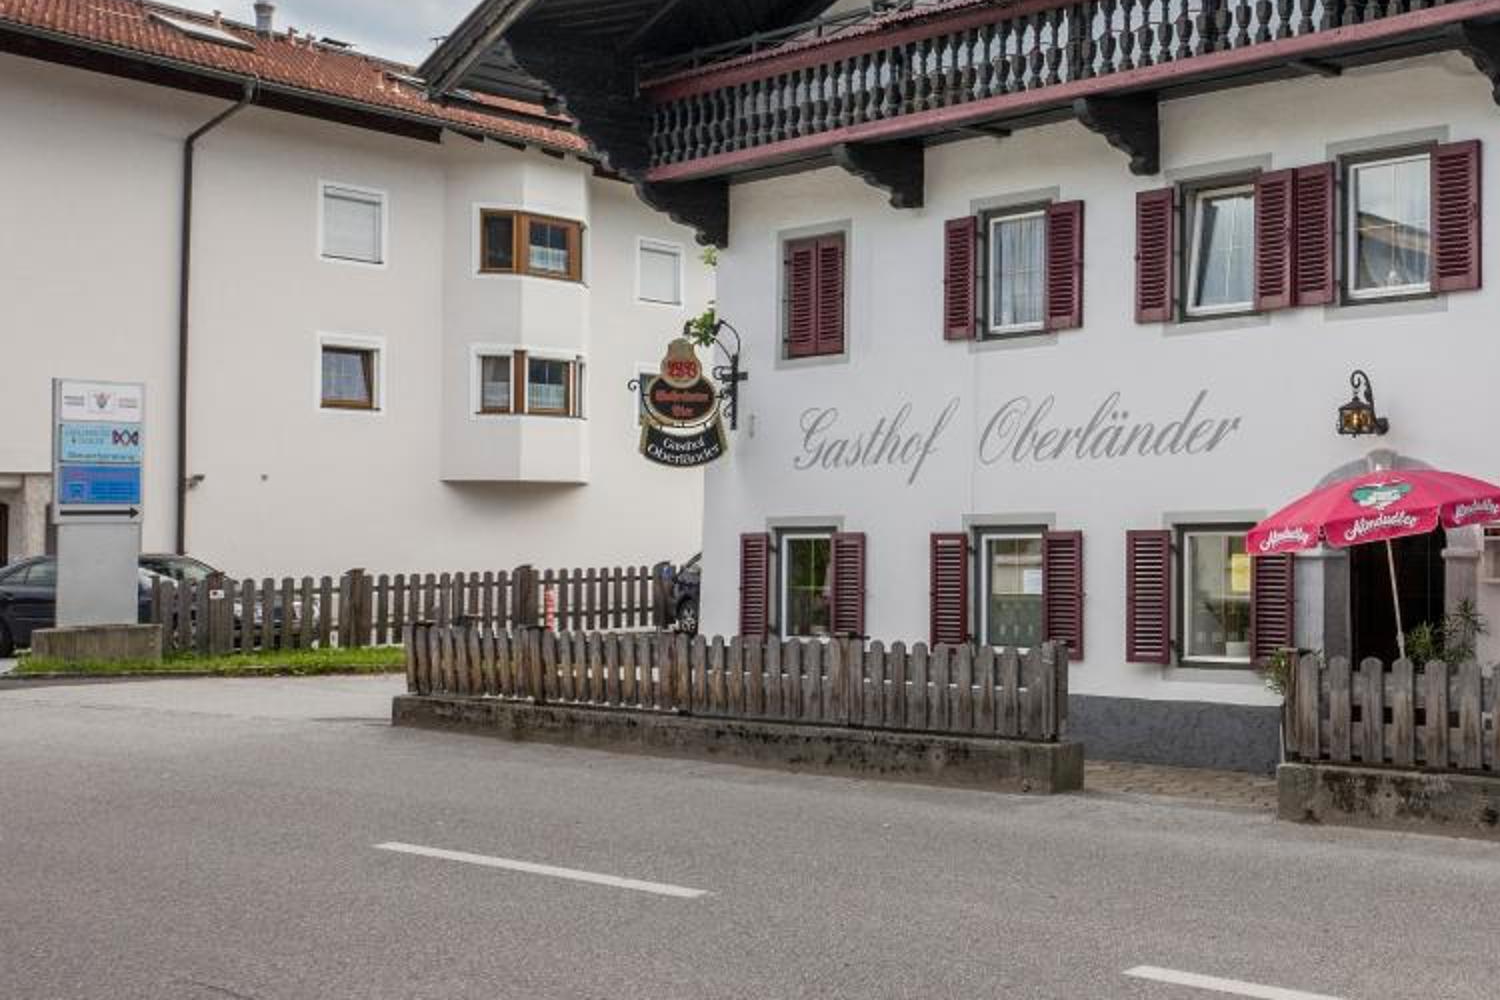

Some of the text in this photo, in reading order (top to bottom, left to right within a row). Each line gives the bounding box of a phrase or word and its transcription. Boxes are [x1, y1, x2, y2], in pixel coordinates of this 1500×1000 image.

[793, 389, 1244, 486] Gasthof Oberländer
[1344, 510, 1419, 541] Almdudler
